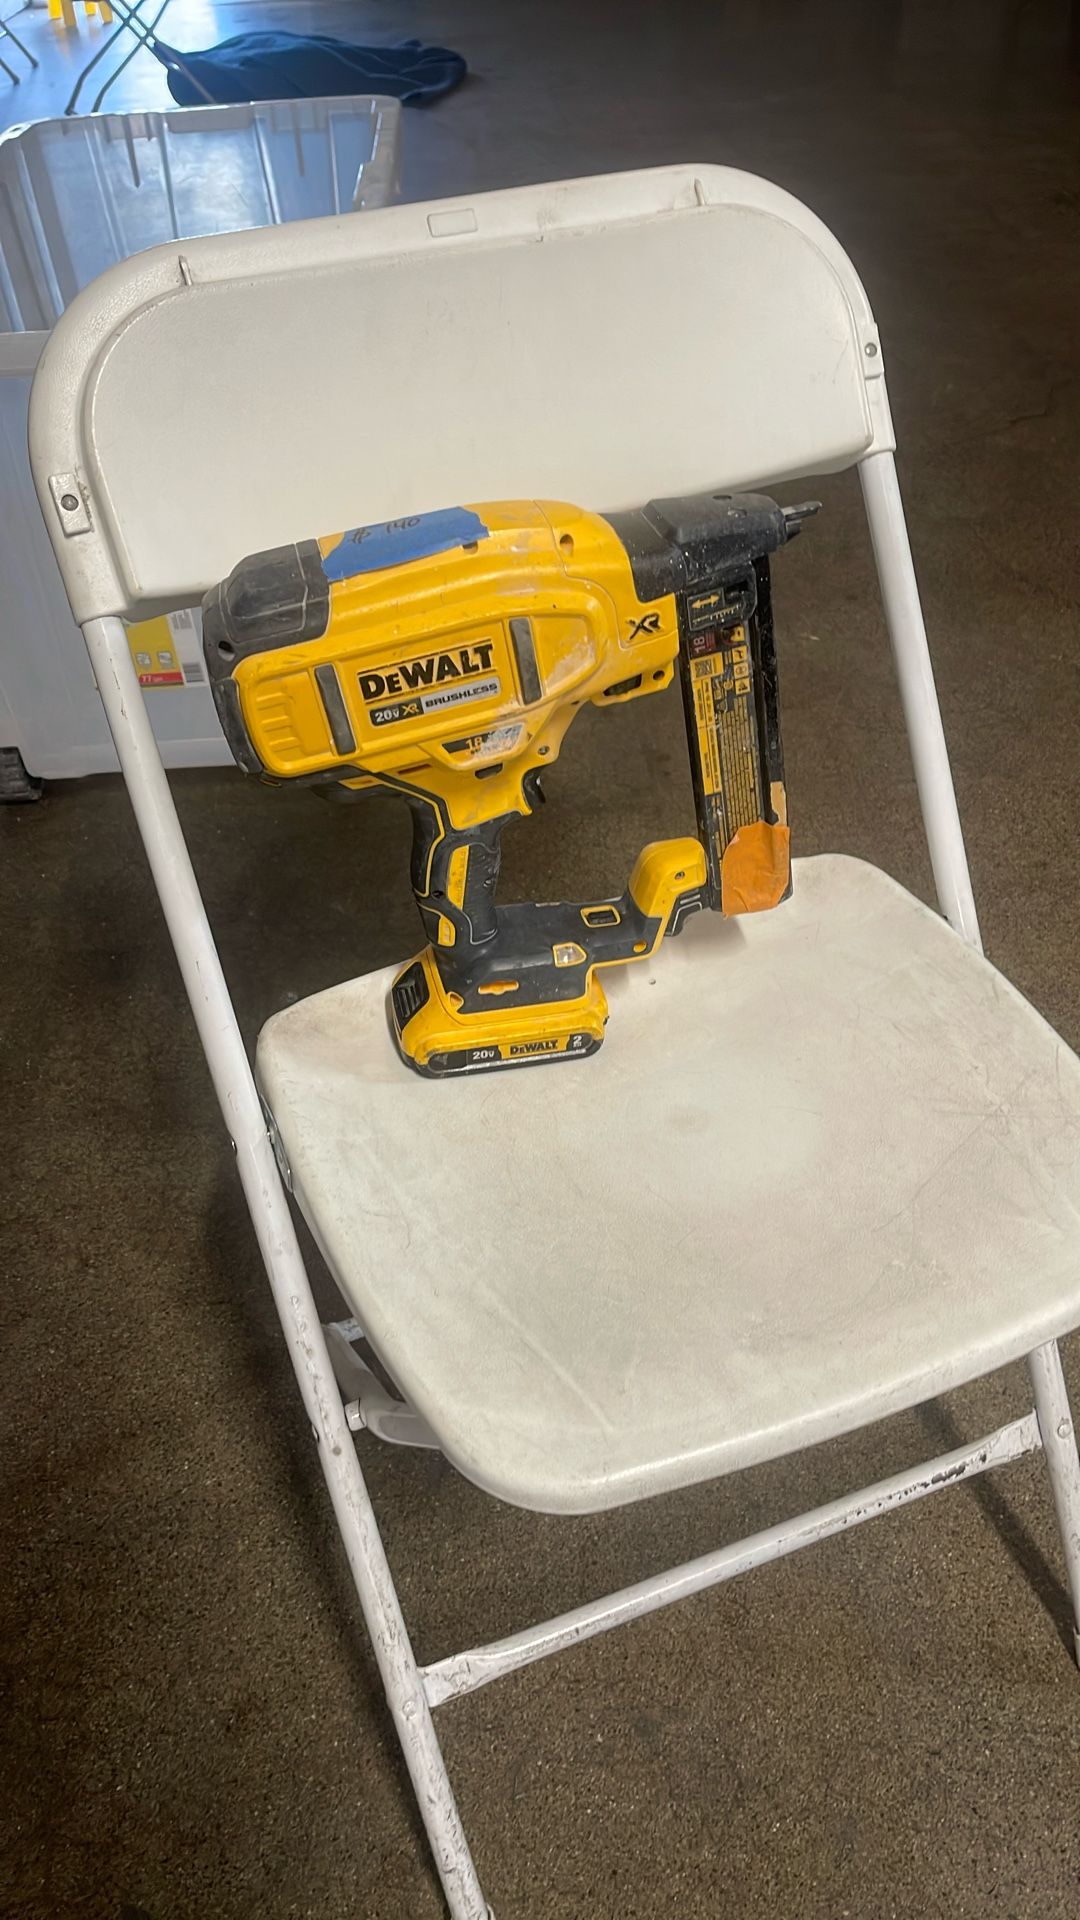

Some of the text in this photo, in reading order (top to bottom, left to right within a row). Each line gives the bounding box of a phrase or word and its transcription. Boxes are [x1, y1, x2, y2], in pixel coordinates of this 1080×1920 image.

[693, 635, 706, 654] 18
[358, 643, 494, 700] DEWALT
[425, 683, 498, 708] BRUSHLESS
[510, 1039, 559, 1056] DEWALT
[573, 1035, 583, 1045] 2
